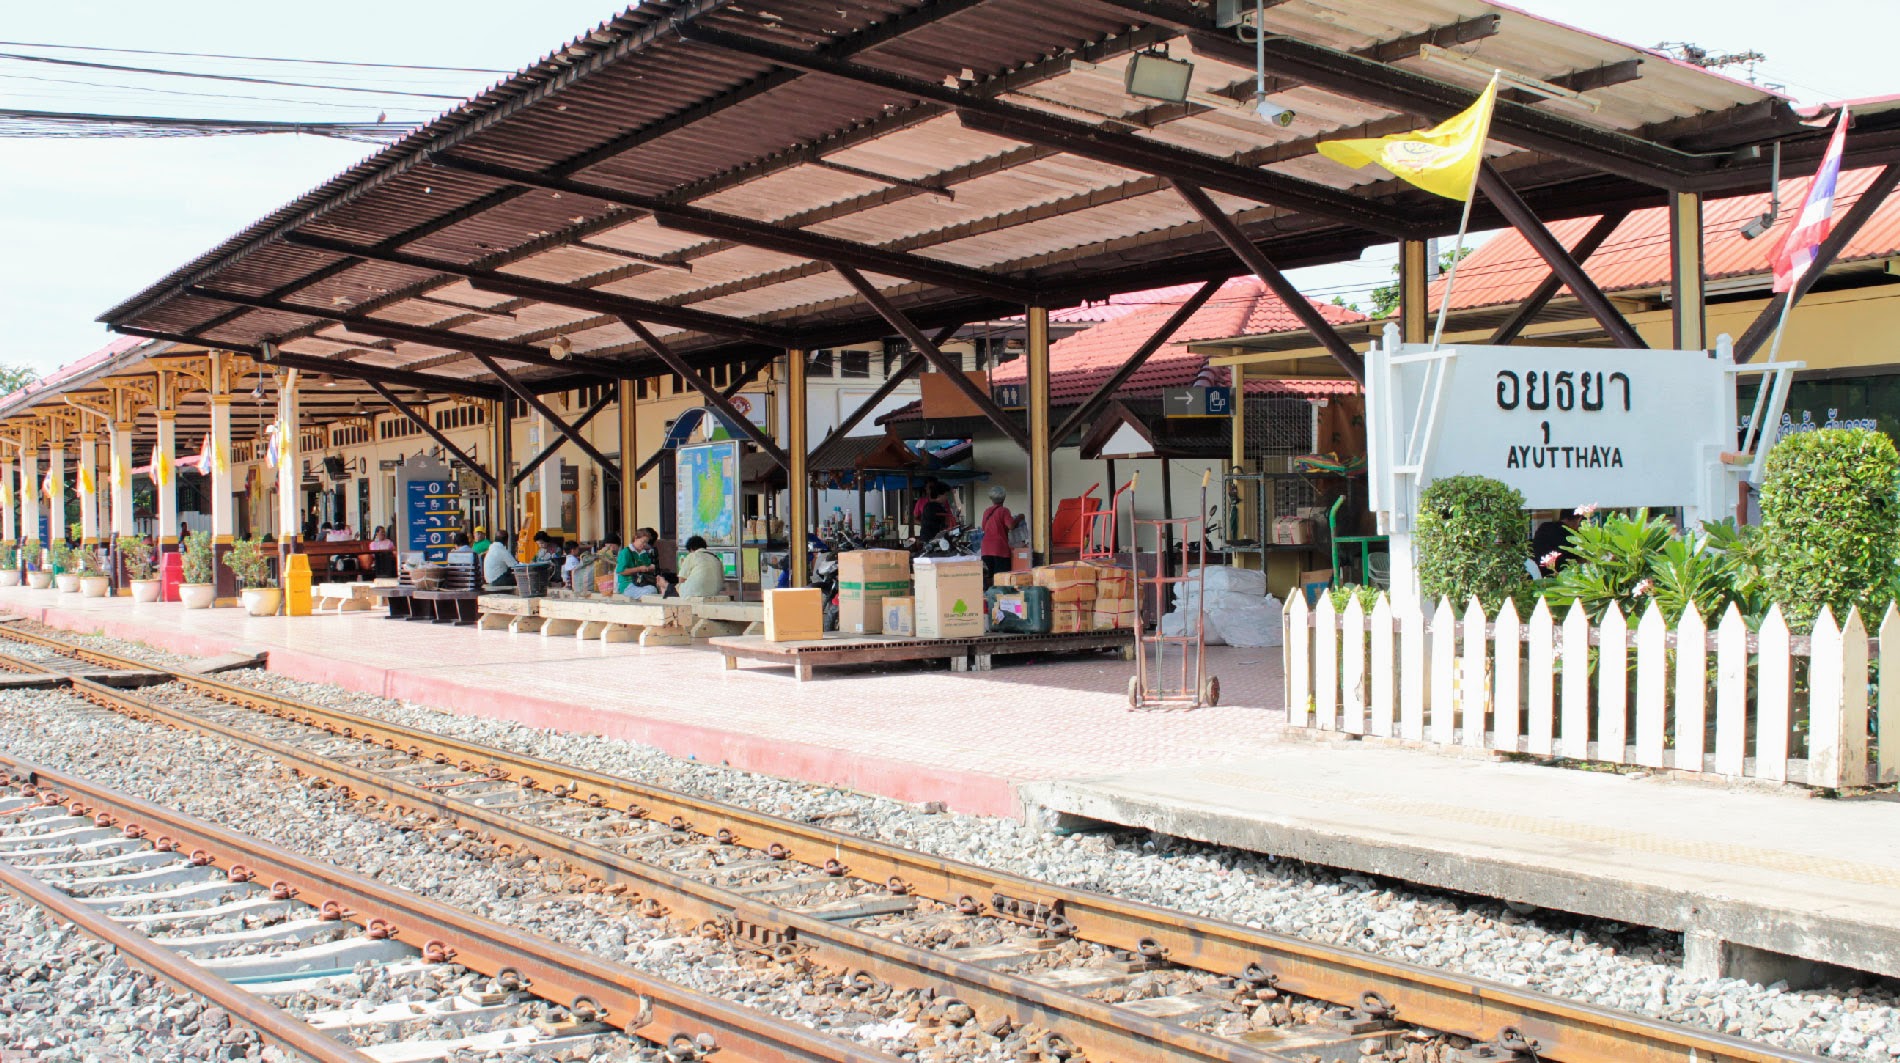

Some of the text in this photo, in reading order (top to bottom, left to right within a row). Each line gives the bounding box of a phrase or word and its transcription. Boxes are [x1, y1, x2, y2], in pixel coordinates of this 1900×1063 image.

[1496, 369, 1631, 444] อยุธยา
[1507, 444, 1624, 468] AYUTTHAYA
